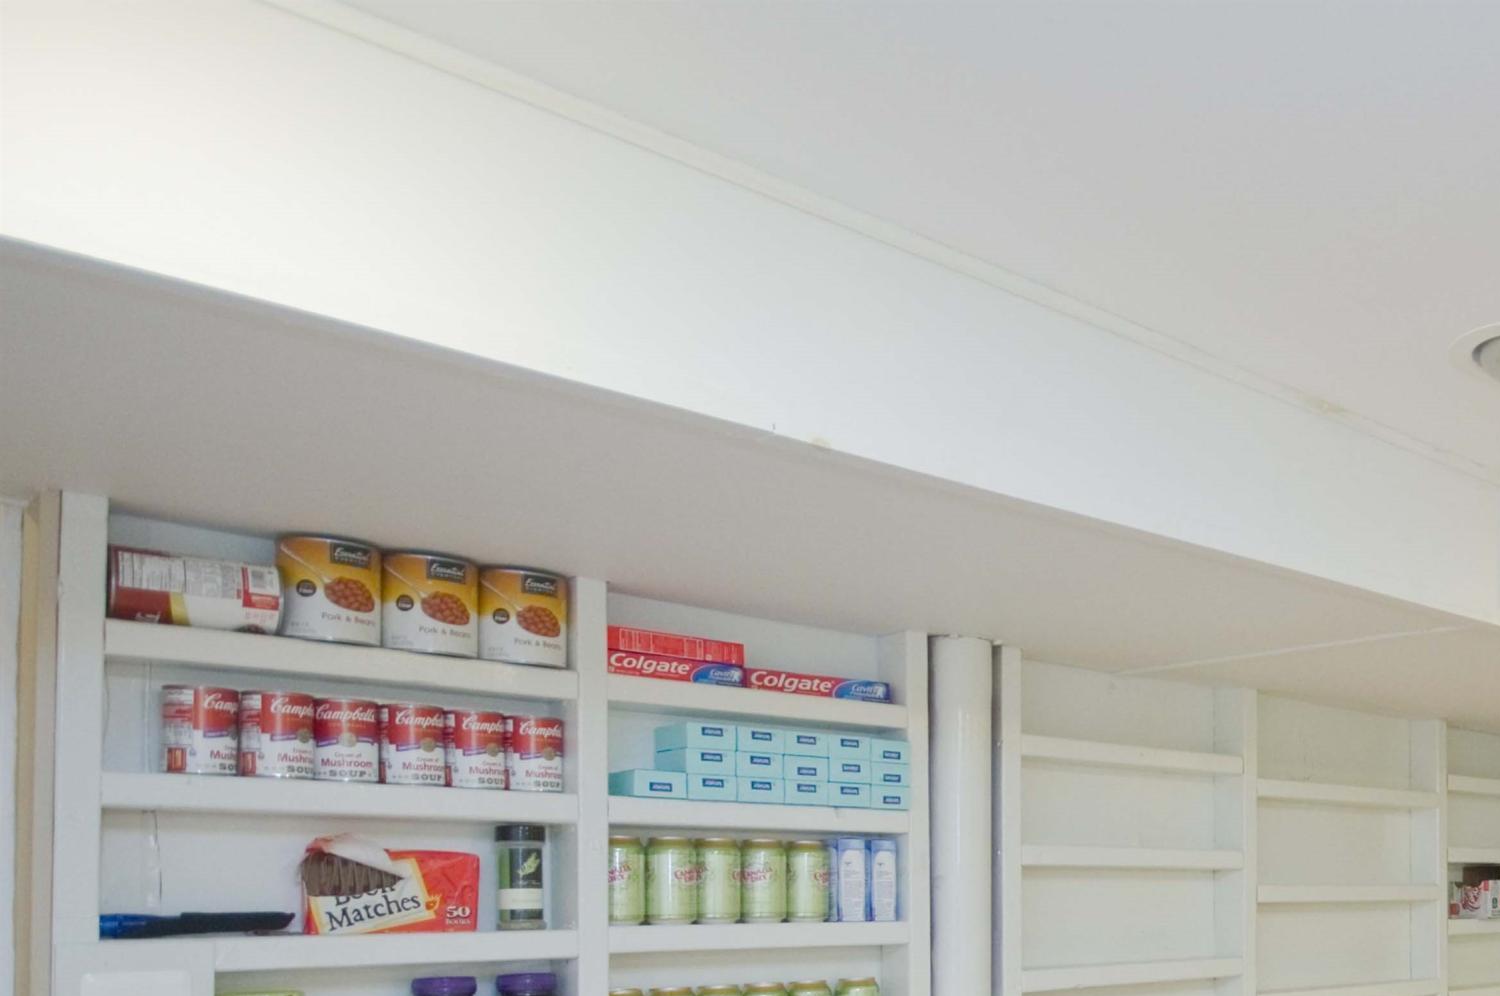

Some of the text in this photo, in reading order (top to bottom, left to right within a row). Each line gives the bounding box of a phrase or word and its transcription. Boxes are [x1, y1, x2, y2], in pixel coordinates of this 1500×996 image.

[609, 652, 690, 675] Colgate
[750, 670, 833, 693] Colgate
[321, 758, 374, 769] Mushroom
[328, 769, 367, 778] SOUP
[325, 895, 421, 932] Matches
[446, 905, 471, 918] 50
